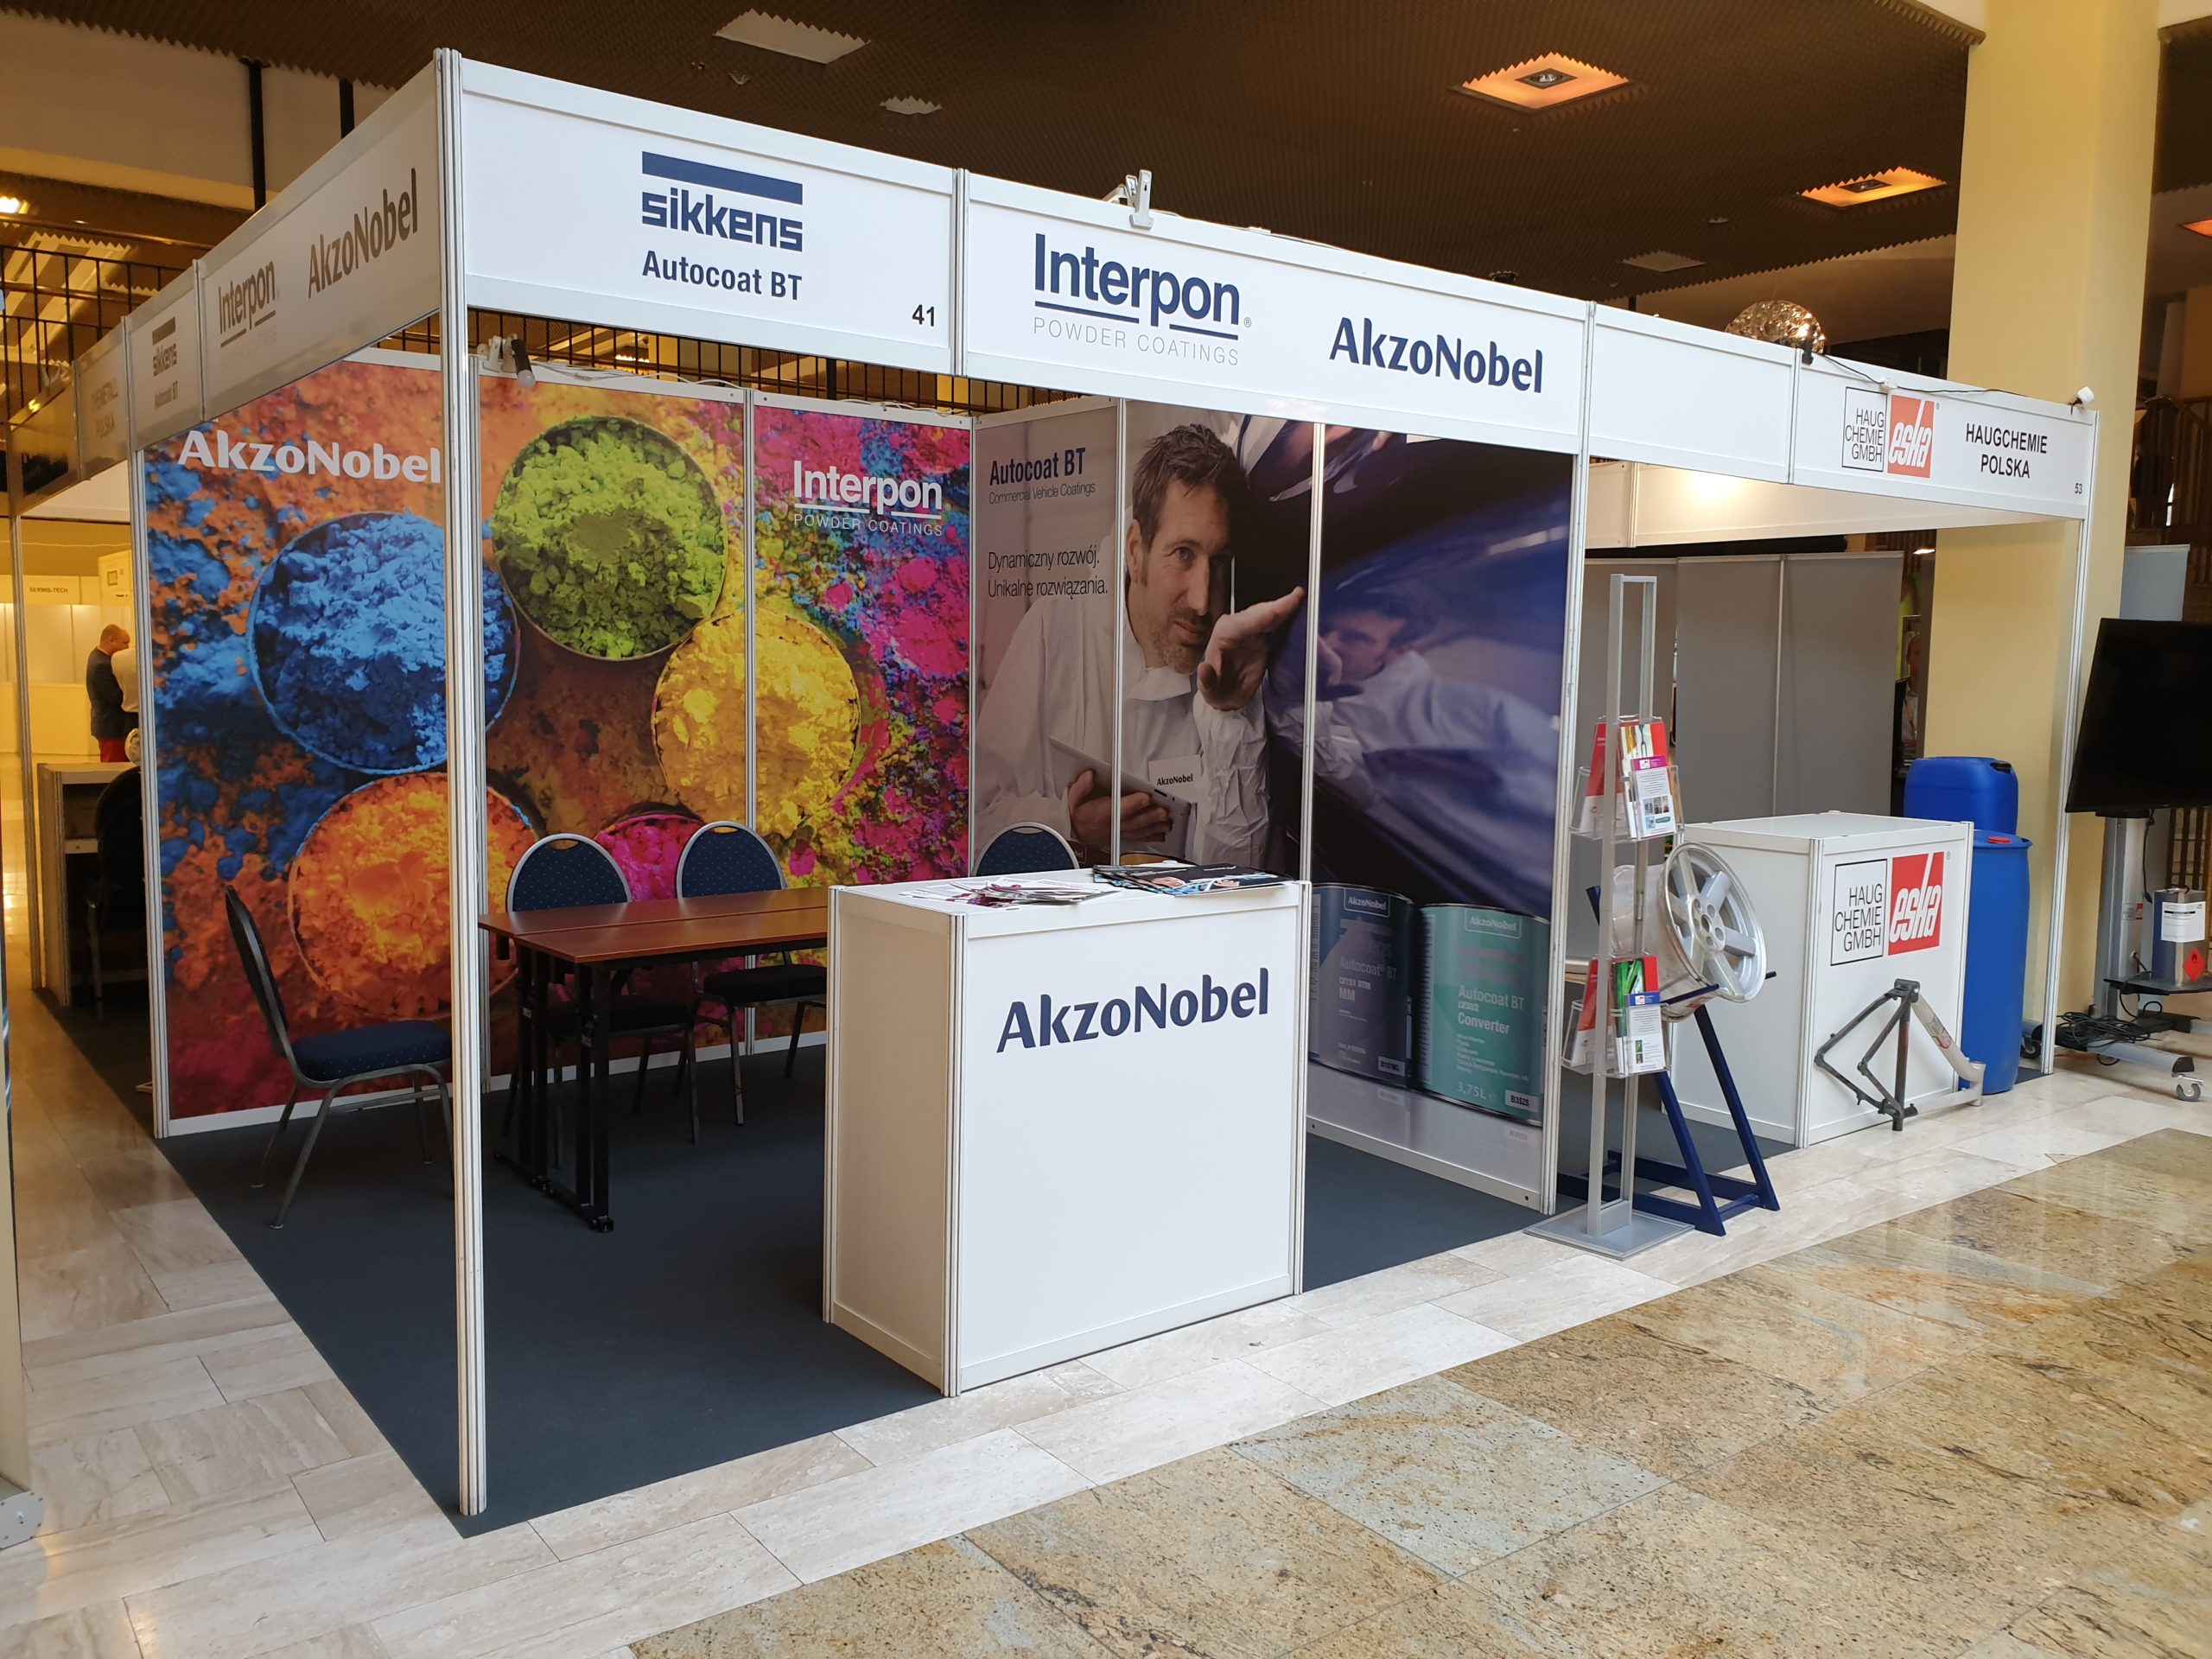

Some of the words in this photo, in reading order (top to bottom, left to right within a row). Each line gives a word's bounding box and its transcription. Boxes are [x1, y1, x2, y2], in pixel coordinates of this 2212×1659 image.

[642, 188, 803, 252] sikkens
[308, 168, 417, 299] AkzoNobel
[642, 250, 762, 295] Autocoat
[771, 271, 803, 301] BT
[1035, 232, 1240, 327] Interpon
[218, 260, 276, 334] Interpon
[912, 304, 935, 327] 41
[1033, 316, 1127, 349] POWDER
[1137, 334, 1238, 366] COATINGS
[153, 343, 177, 377] sikkens
[1329, 316, 1542, 393] AkzoNobel
[1856, 408, 1885, 429] HAUG
[1845, 424, 1884, 447] CHEMIE
[1889, 400, 1932, 468] eska
[1966, 423, 2048, 454] HAUGCHEMIE
[178, 429, 441, 484] AkzoNobel
[1852, 443, 1883, 463] GMBH
[989, 454, 1059, 486] Autocoat
[1065, 448, 1086, 475] BT
[1980, 454, 2031, 479] POLSKA
[794, 460, 942, 515] Interpon
[989, 485, 1031, 505] Commercial
[1033, 485, 1058, 501] Vehicle
[1060, 481, 1096, 498] Coatings
[2075, 482, 2082, 495] 53
[794, 513, 861, 531] POWDER
[868, 519, 943, 537] COATINGS
[988, 549, 1054, 572] Dynamiczny
[1057, 545, 1101, 567] rozwój.
[988, 577, 1033, 598] Unikalne
[1036, 576, 1109, 601] rozwiązania.
[1156, 772, 1193, 786] AkzoNobel
[1347, 895, 1386, 911] AkzoNobel
[1849, 883, 1882, 907] HAUG
[1889, 853, 1942, 944] eska
[1470, 916, 1516, 931] AkzoNobel
[1834, 906, 1882, 932] CHEMIE
[1843, 927, 1881, 952] GMBH
[1386, 966, 1397, 980] BT
[1338, 987, 1356, 1002] MM
[1458, 985, 1510, 1007] Autocoat
[1511, 995, 1525, 1010] BT
[996, 967, 1269, 1053] AkzoNobel
[1458, 1012, 1510, 1035] Converter
[1457, 1083, 1486, 1099] 3.75L
